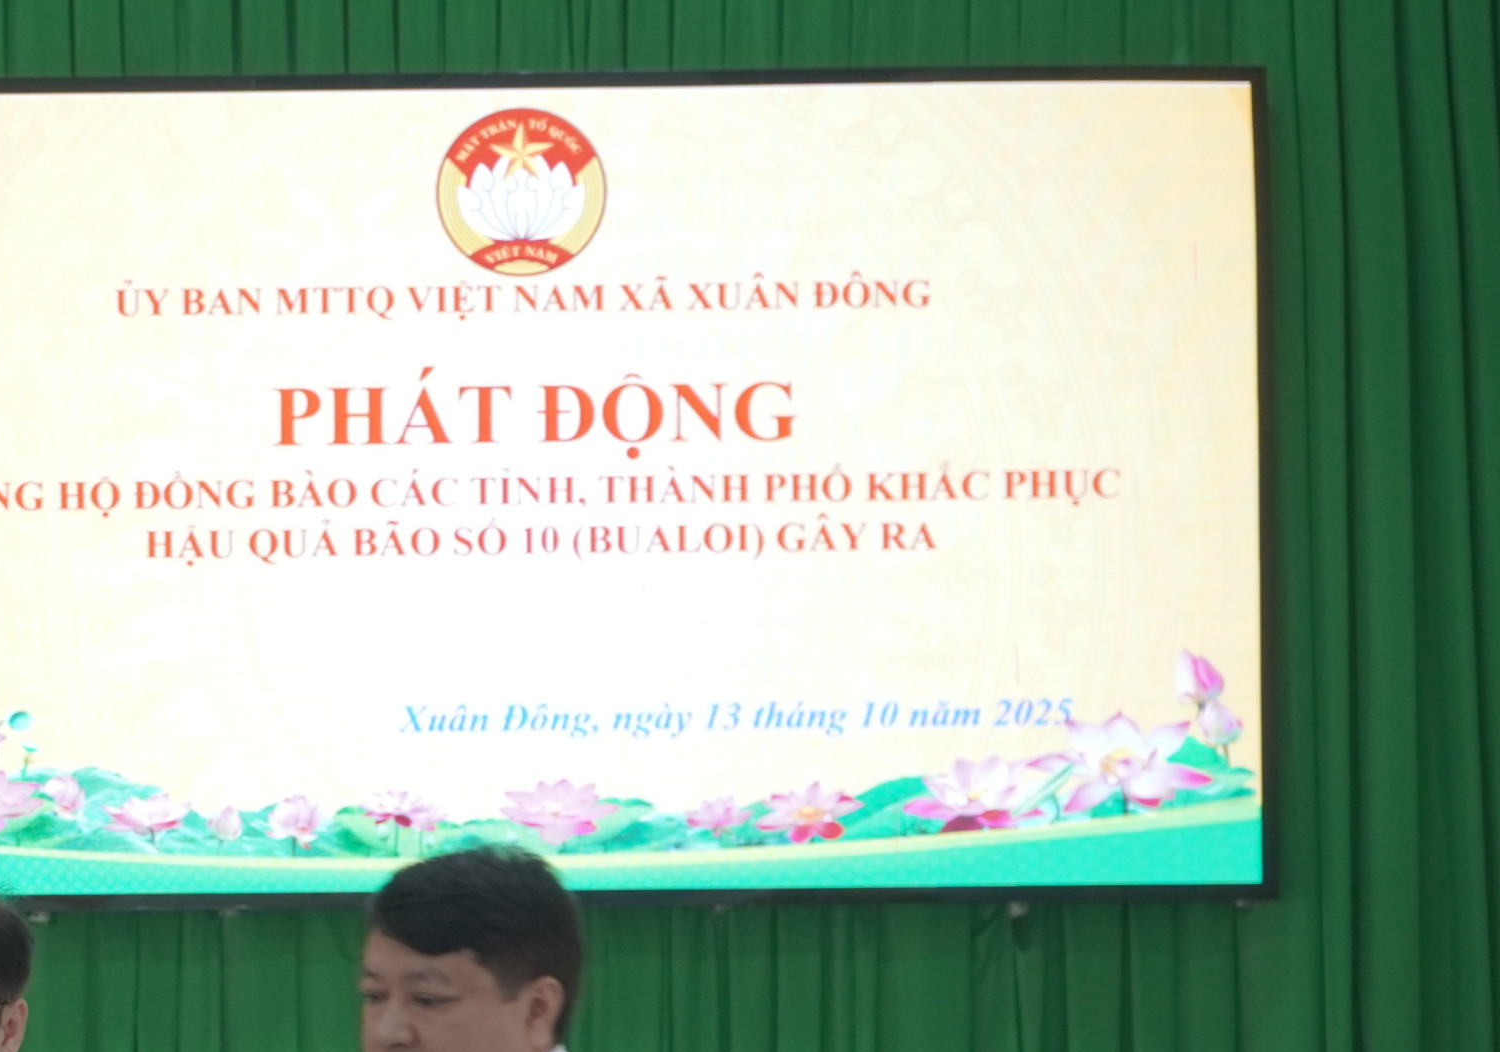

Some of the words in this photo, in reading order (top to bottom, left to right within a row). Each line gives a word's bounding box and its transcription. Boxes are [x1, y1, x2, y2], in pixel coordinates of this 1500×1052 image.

[524, 245, 558, 264] NAM
[115, 279, 170, 317] ỦY
[181, 286, 262, 316] BAN
[275, 285, 395, 321] MTTQ
[407, 280, 503, 321] VIỆT
[513, 282, 605, 313] NAM
[619, 275, 675, 312] XÃ
[688, 271, 799, 312] XUÂN
[812, 270, 931, 310] ĐÔNG
[272, 366, 512, 447] PHÁT
[537, 373, 798, 460] ĐỘNG
[58, 476, 121, 518] HỘ
[133, 470, 255, 510] ĐỒNG
[270, 468, 357, 509] BÀO
[371, 468, 458, 508] CÁC
[470, 467, 587, 508] TỈNH,
[598, 465, 748, 504] THÀNH
[763, 462, 852, 503] PHỐ
[1004, 468, 1121, 507] PHỤC
[145, 525, 234, 567] HẬU
[248, 519, 338, 565] QUẢ
[353, 520, 441, 557] BÃO
[453, 517, 507, 556] SỐ
[524, 525, 559, 555] 10
[573, 523, 765, 561] (BUALOI)
[776, 513, 867, 553] GÂY
[880, 522, 938, 551] RA
[399, 703, 489, 734] Xuân
[501, 703, 599, 738] Đông,
[612, 702, 693, 739] ngày
[705, 702, 742, 731] 13
[752, 700, 849, 738] tháng
[861, 701, 900, 729] 10
[909, 700, 982, 729] năm
[994, 698, 1074, 728] 2025
